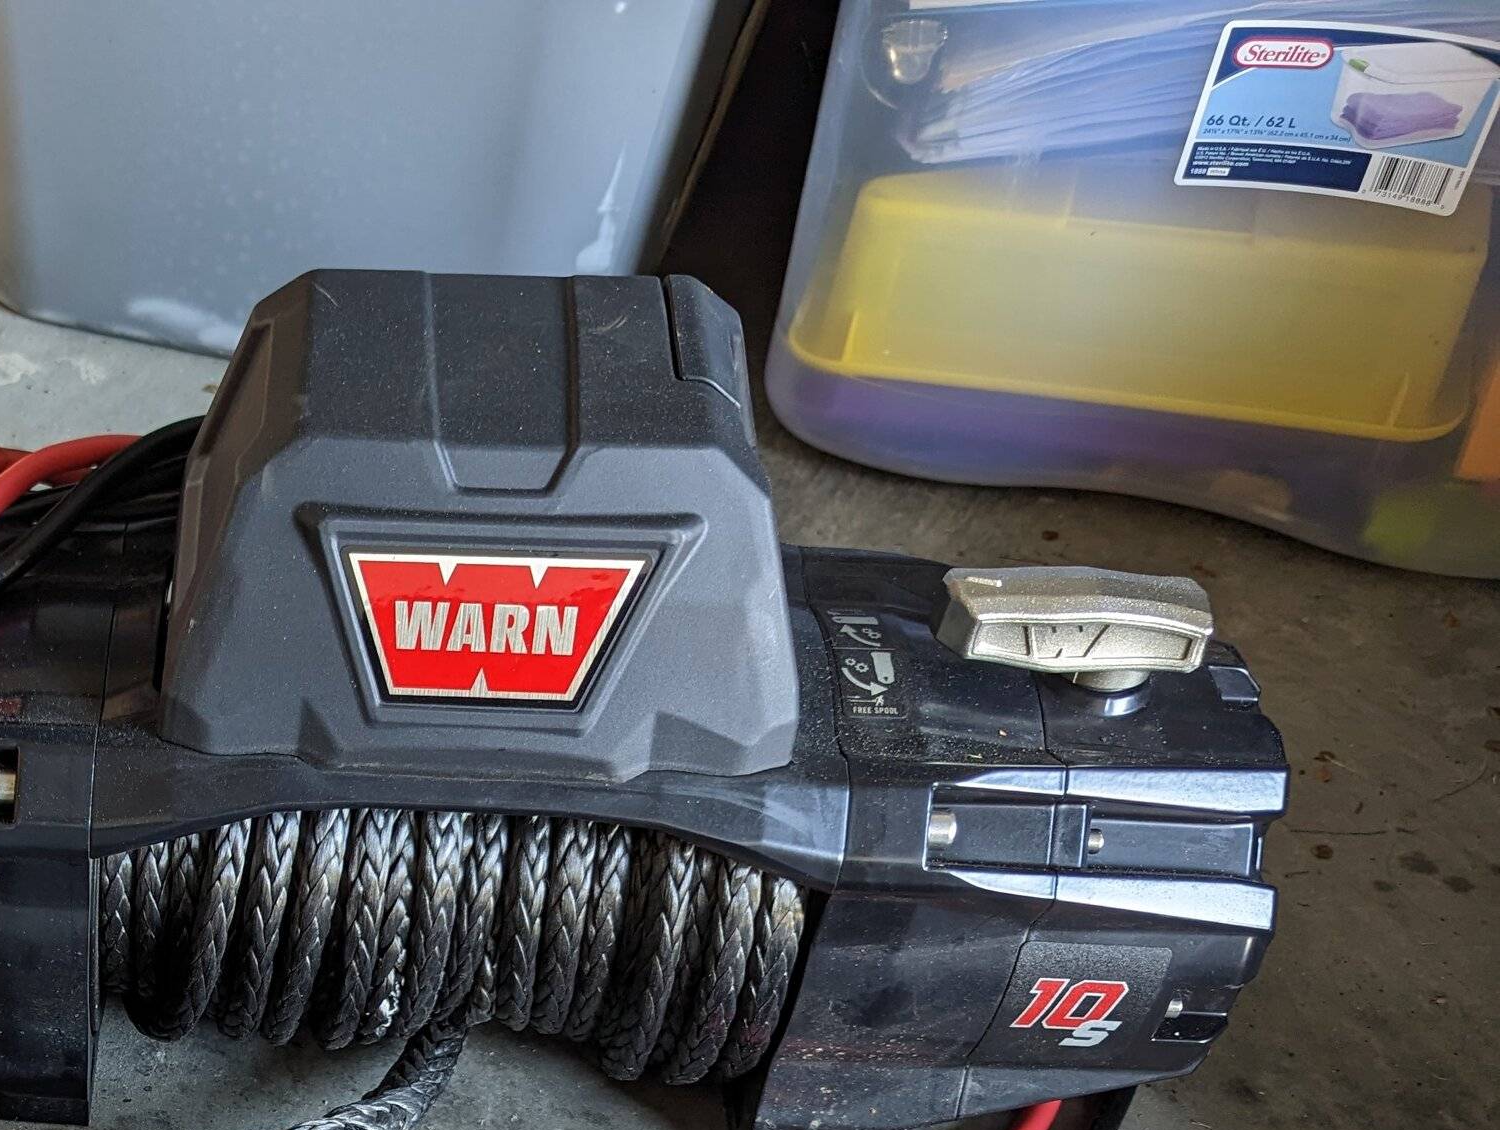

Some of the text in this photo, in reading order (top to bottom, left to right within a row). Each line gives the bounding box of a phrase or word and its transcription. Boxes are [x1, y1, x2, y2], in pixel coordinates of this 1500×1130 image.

[1244, 44, 1321, 63] Sterilite
[1206, 115, 1224, 126] 66
[1229, 115, 1250, 127] Qt.
[1266, 117, 1285, 128] 62
[1288, 118, 1296, 128] L
[395, 600, 578, 656] WARN
[853, 706, 899, 715] FREE SPOOL
[1009, 977, 1130, 1030] 10
[1058, 1020, 1123, 1047] S
